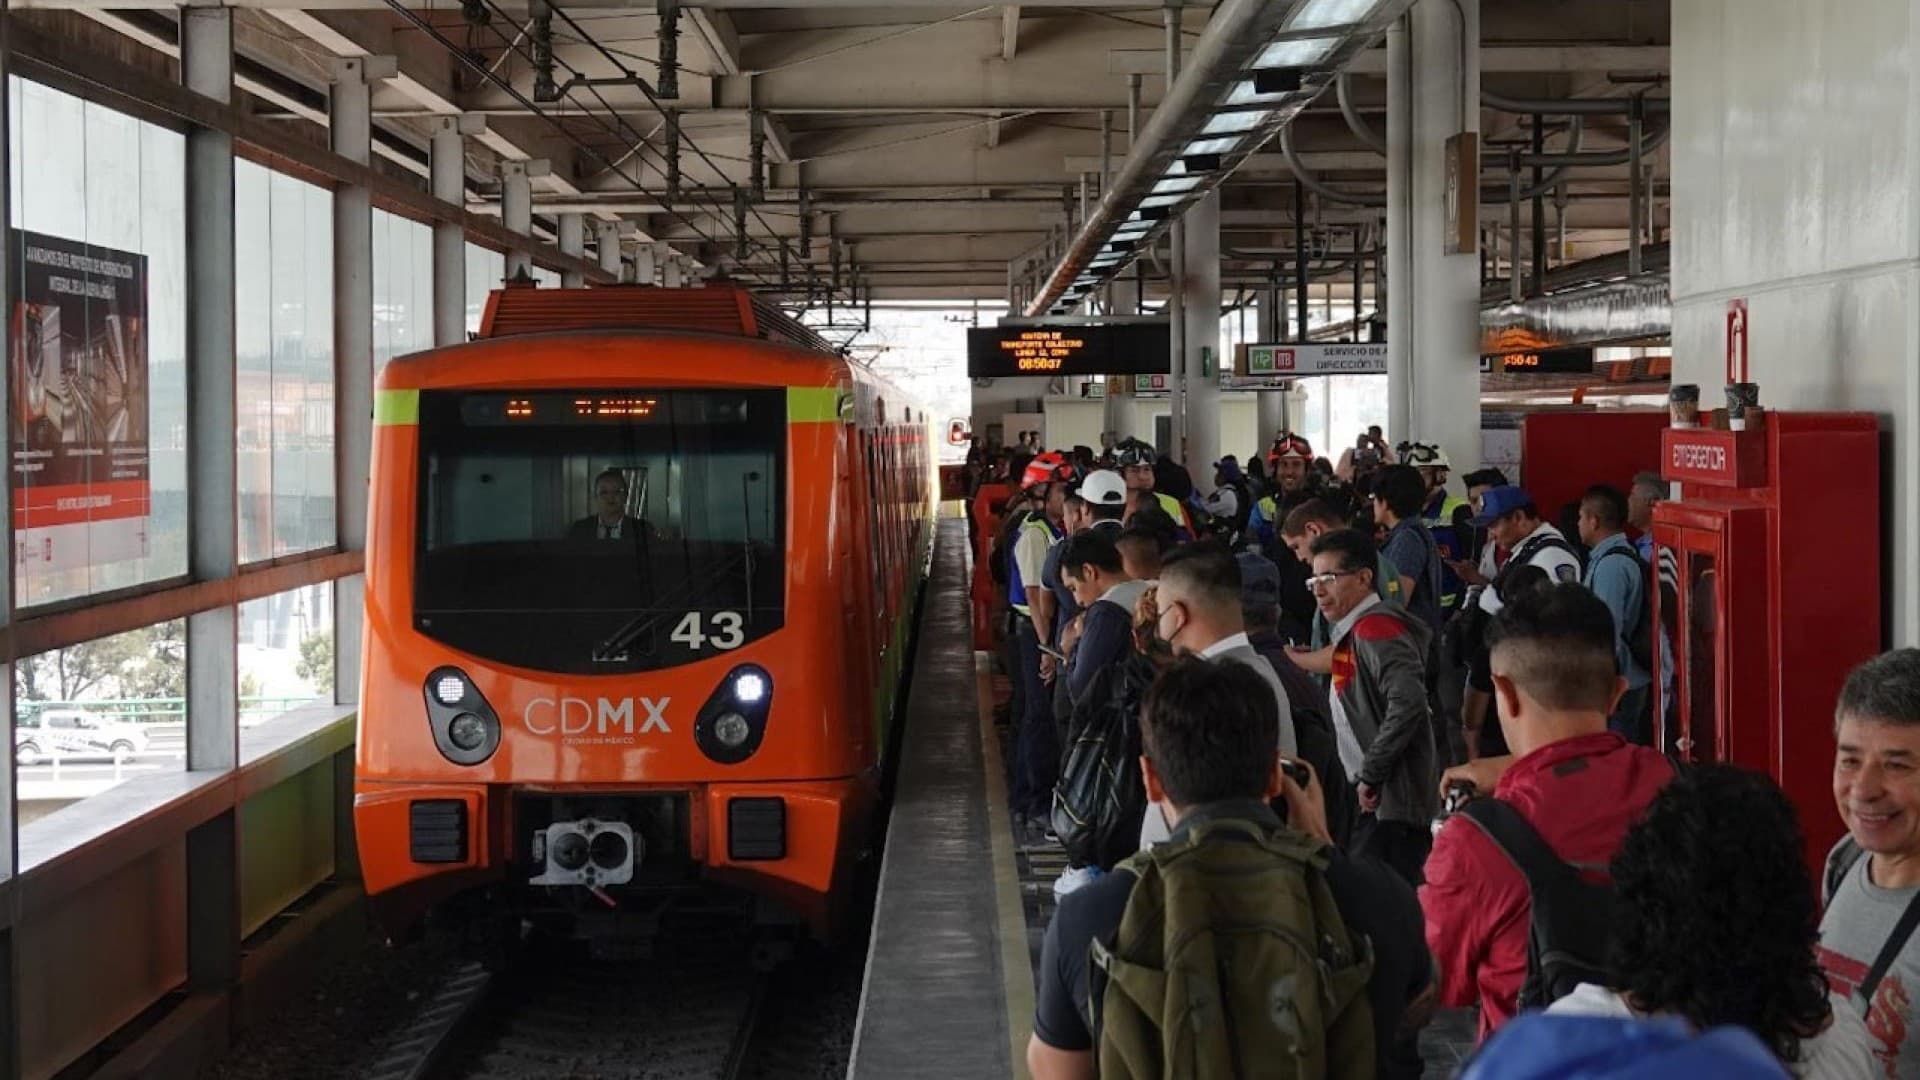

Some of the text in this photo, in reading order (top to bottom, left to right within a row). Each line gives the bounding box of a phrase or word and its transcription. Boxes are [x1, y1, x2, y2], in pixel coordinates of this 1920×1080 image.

[1323, 347, 1367, 356] SERVICIO
[1368, 347, 1381, 356] DE
[670, 610, 745, 650] 43
[523, 696, 671, 734] CDMX
